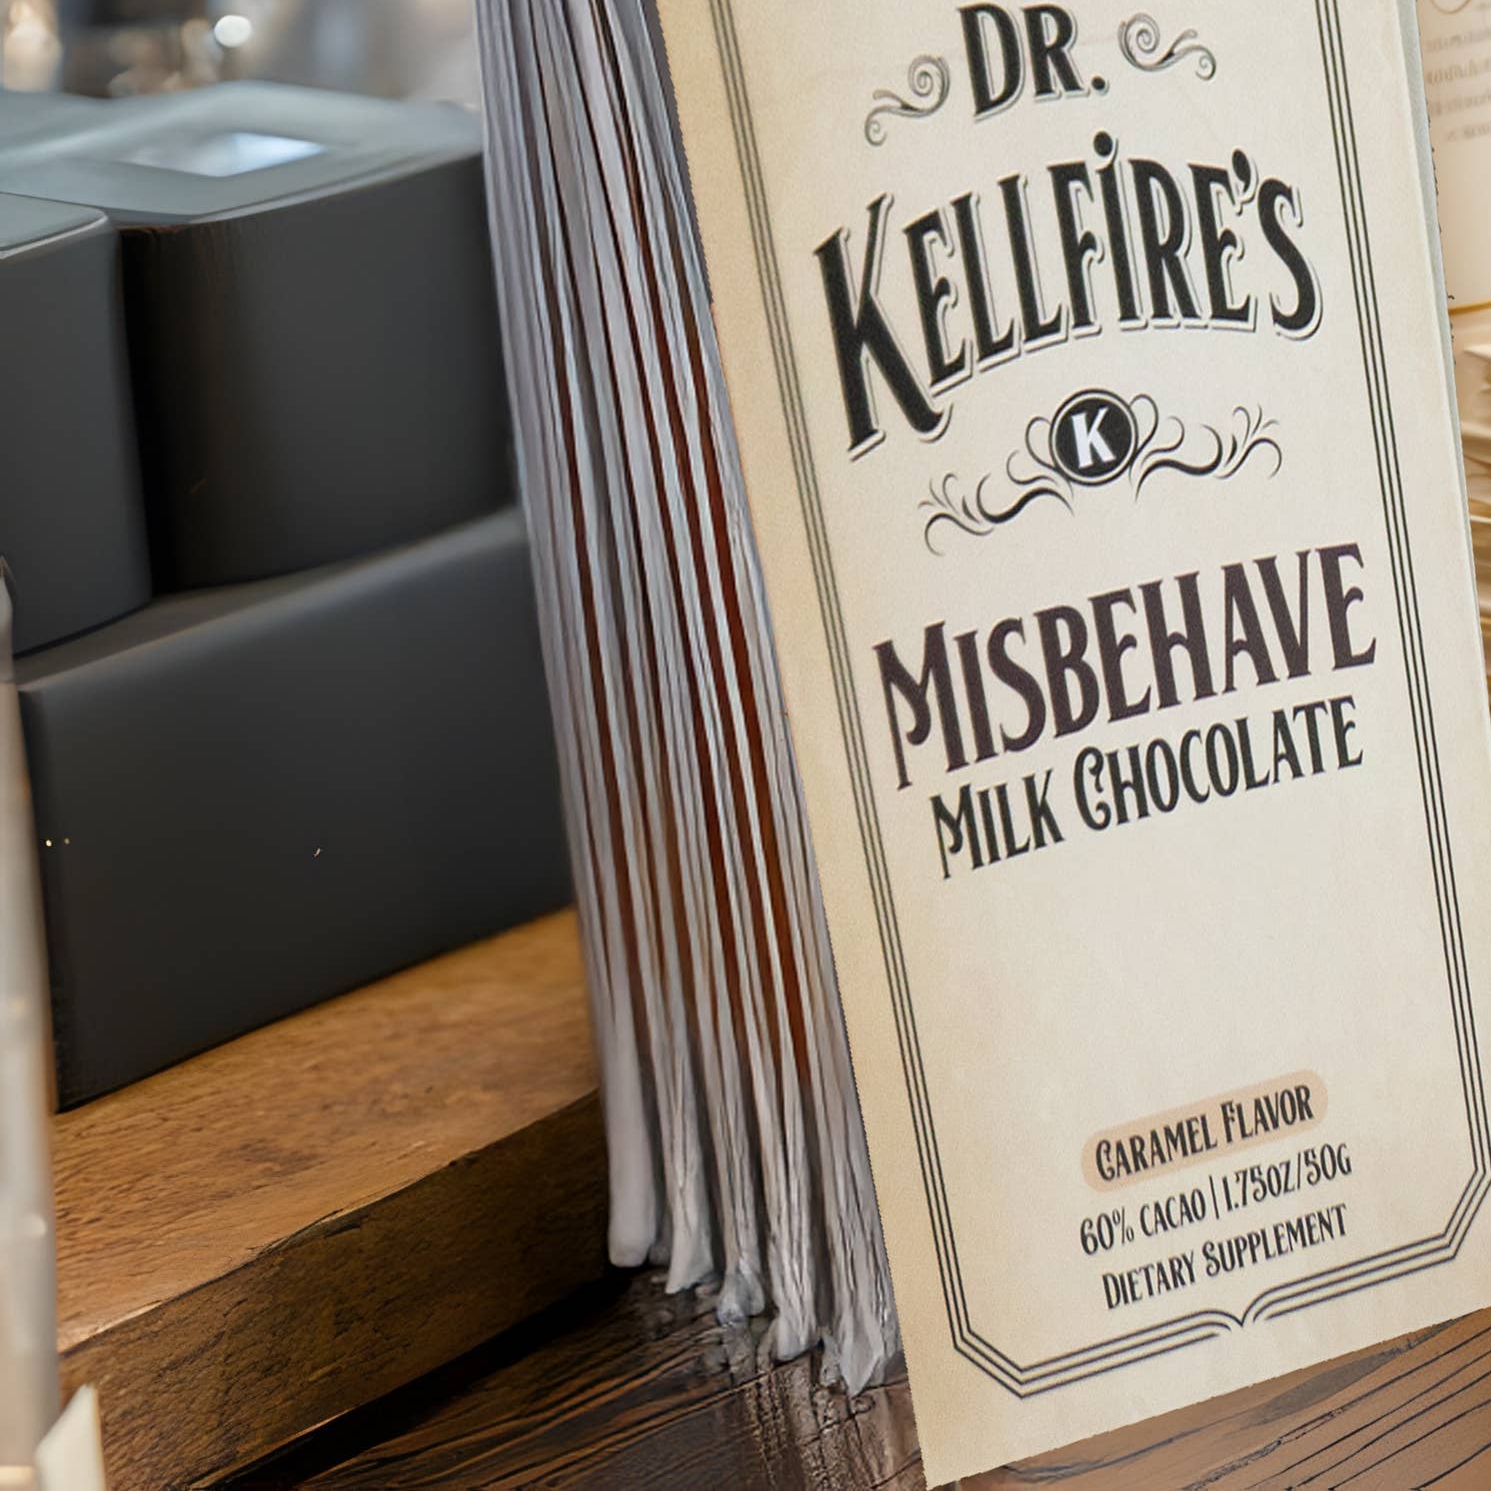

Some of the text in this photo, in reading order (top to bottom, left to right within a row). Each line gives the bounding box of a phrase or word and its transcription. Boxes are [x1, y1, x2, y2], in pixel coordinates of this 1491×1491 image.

[956, 2, 1109, 122] DR.
[1071, 406, 1117, 470] K
[872, 541, 1378, 791] MISBEHAVE
[929, 694, 1364, 881] MILK CHOCOLATE
[1095, 1084, 1315, 1183] CARAMEL FLAVOR
[1079, 1207, 1136, 1257] 60%
[1140, 1187, 1206, 1238] CACAO
[1101, 1202, 1349, 1311] DIETARY SUPPLEMENT
